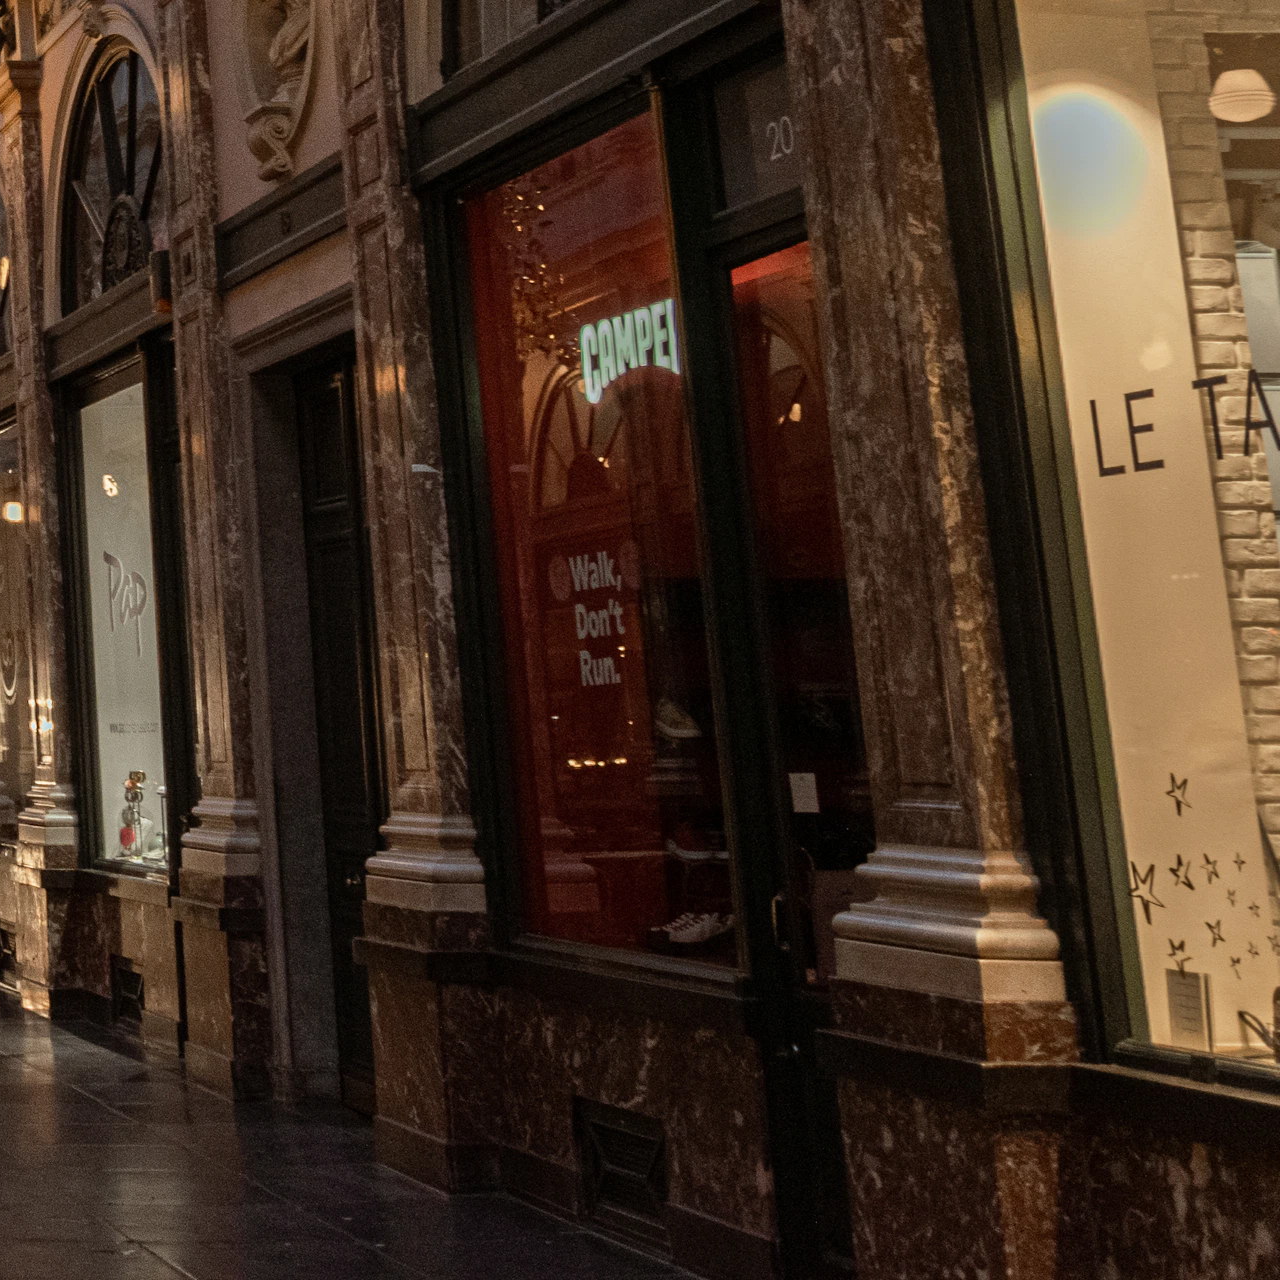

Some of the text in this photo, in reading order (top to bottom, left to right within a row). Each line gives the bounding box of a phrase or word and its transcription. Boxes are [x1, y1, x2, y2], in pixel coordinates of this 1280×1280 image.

[766, 115, 794, 160] 20
[580, 299, 680, 404] CAMPE
[1089, 388, 1165, 477] LE
[568, 550, 623, 592] Walk,
[574, 598, 626, 640] Don't
[579, 649, 622, 687] Run.
